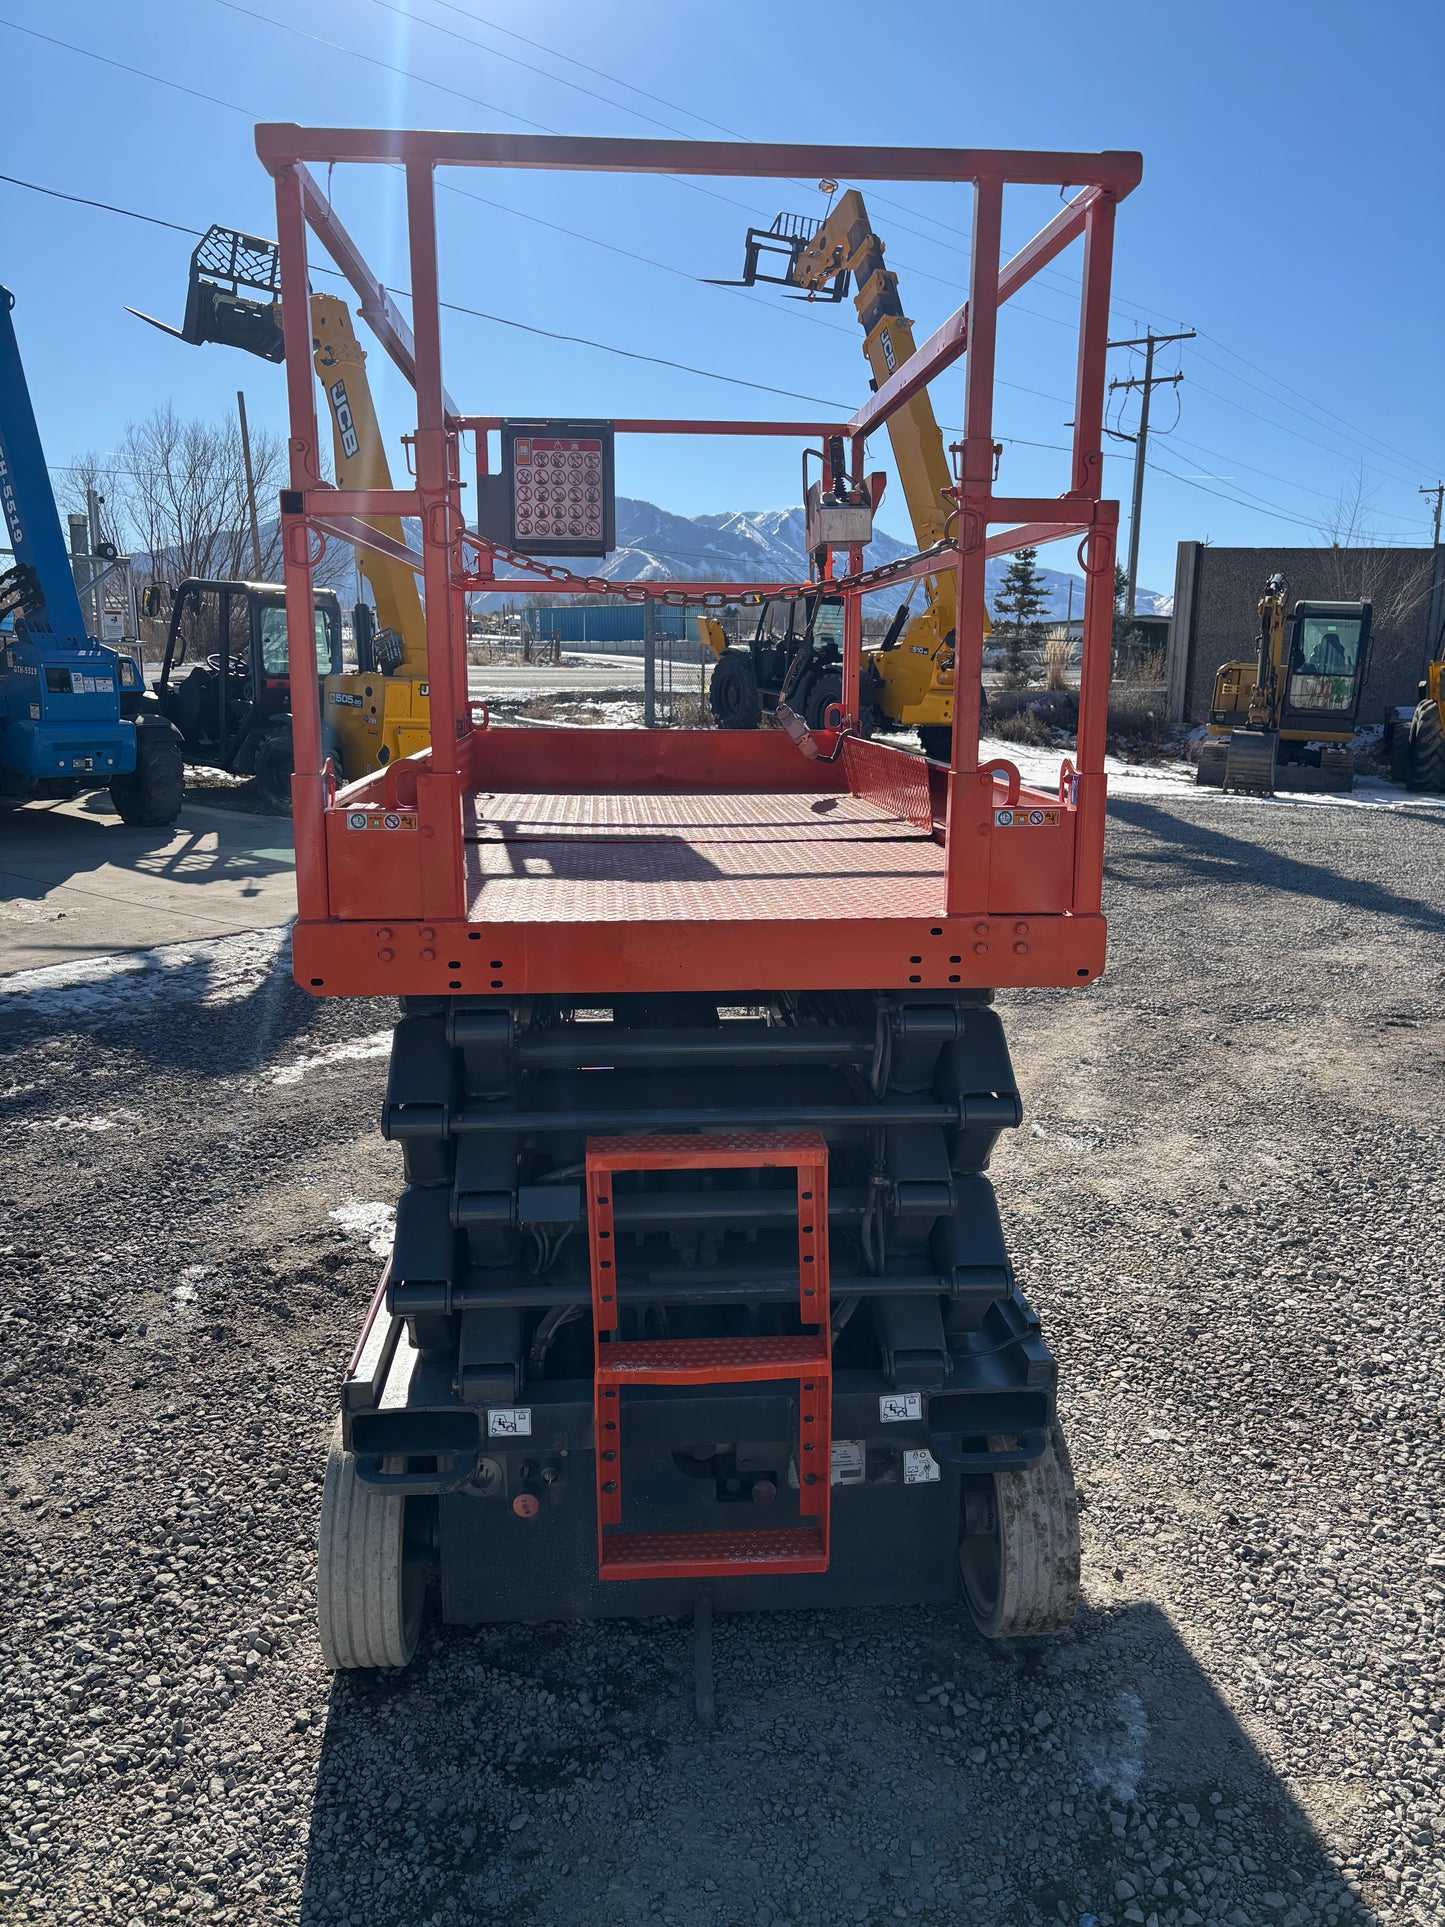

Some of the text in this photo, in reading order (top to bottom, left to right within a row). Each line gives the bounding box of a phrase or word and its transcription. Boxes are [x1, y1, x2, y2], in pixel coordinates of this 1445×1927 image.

[881, 330, 896, 370] JCB
[331, 384, 358, 457] JCB
[0, 446, 22, 543] H-5519
[13, 665, 37, 675] GTH-5519
